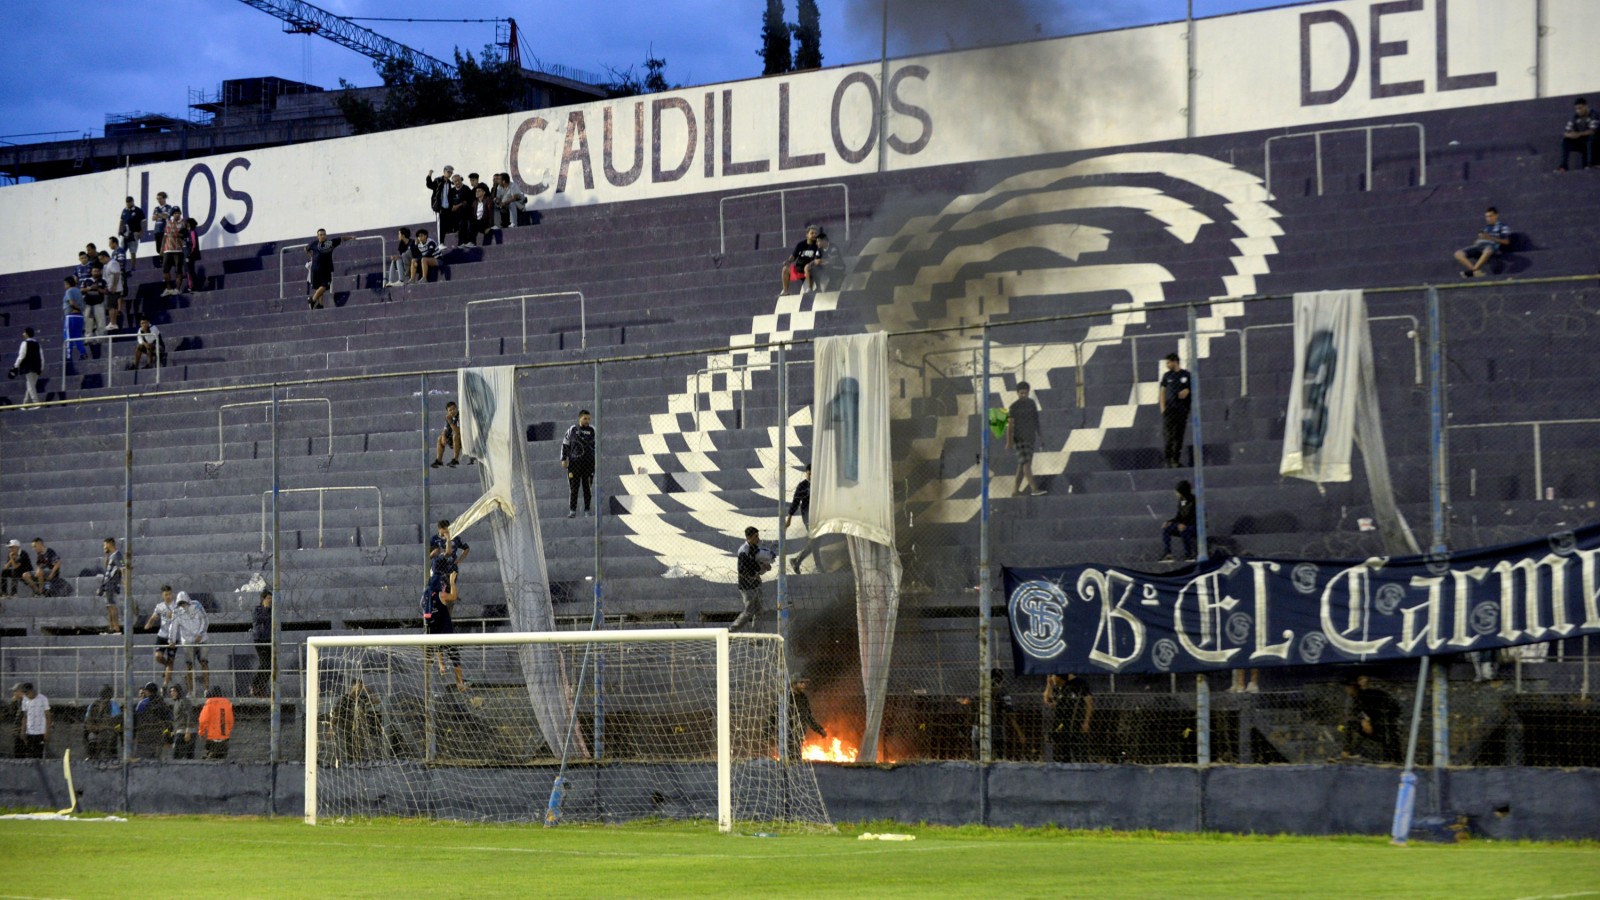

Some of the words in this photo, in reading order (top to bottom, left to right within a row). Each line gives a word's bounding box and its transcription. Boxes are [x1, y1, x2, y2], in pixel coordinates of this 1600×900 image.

[138, 156, 254, 243] LOS
[510, 64, 932, 196] CAUDILLOS
[1299, 0, 1498, 108] DEL
